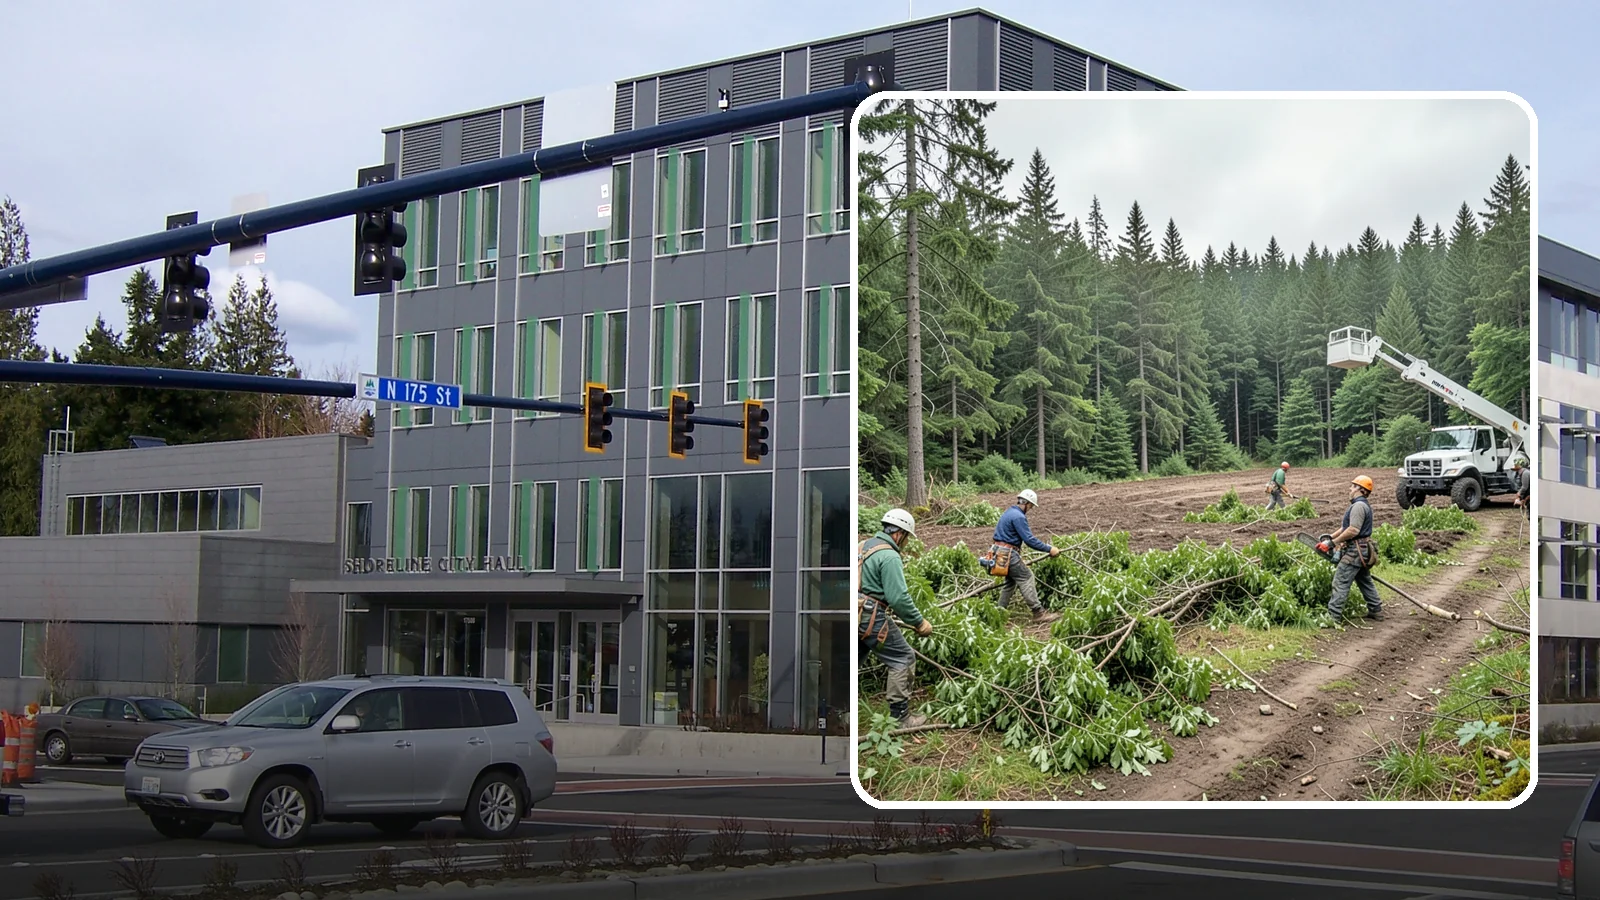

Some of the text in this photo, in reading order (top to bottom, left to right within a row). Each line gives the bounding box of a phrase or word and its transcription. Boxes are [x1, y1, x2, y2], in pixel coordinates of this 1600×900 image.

[387, 380, 451, 406] N 175 St
[344, 555, 524, 574] SHORELINE CITY HALL
